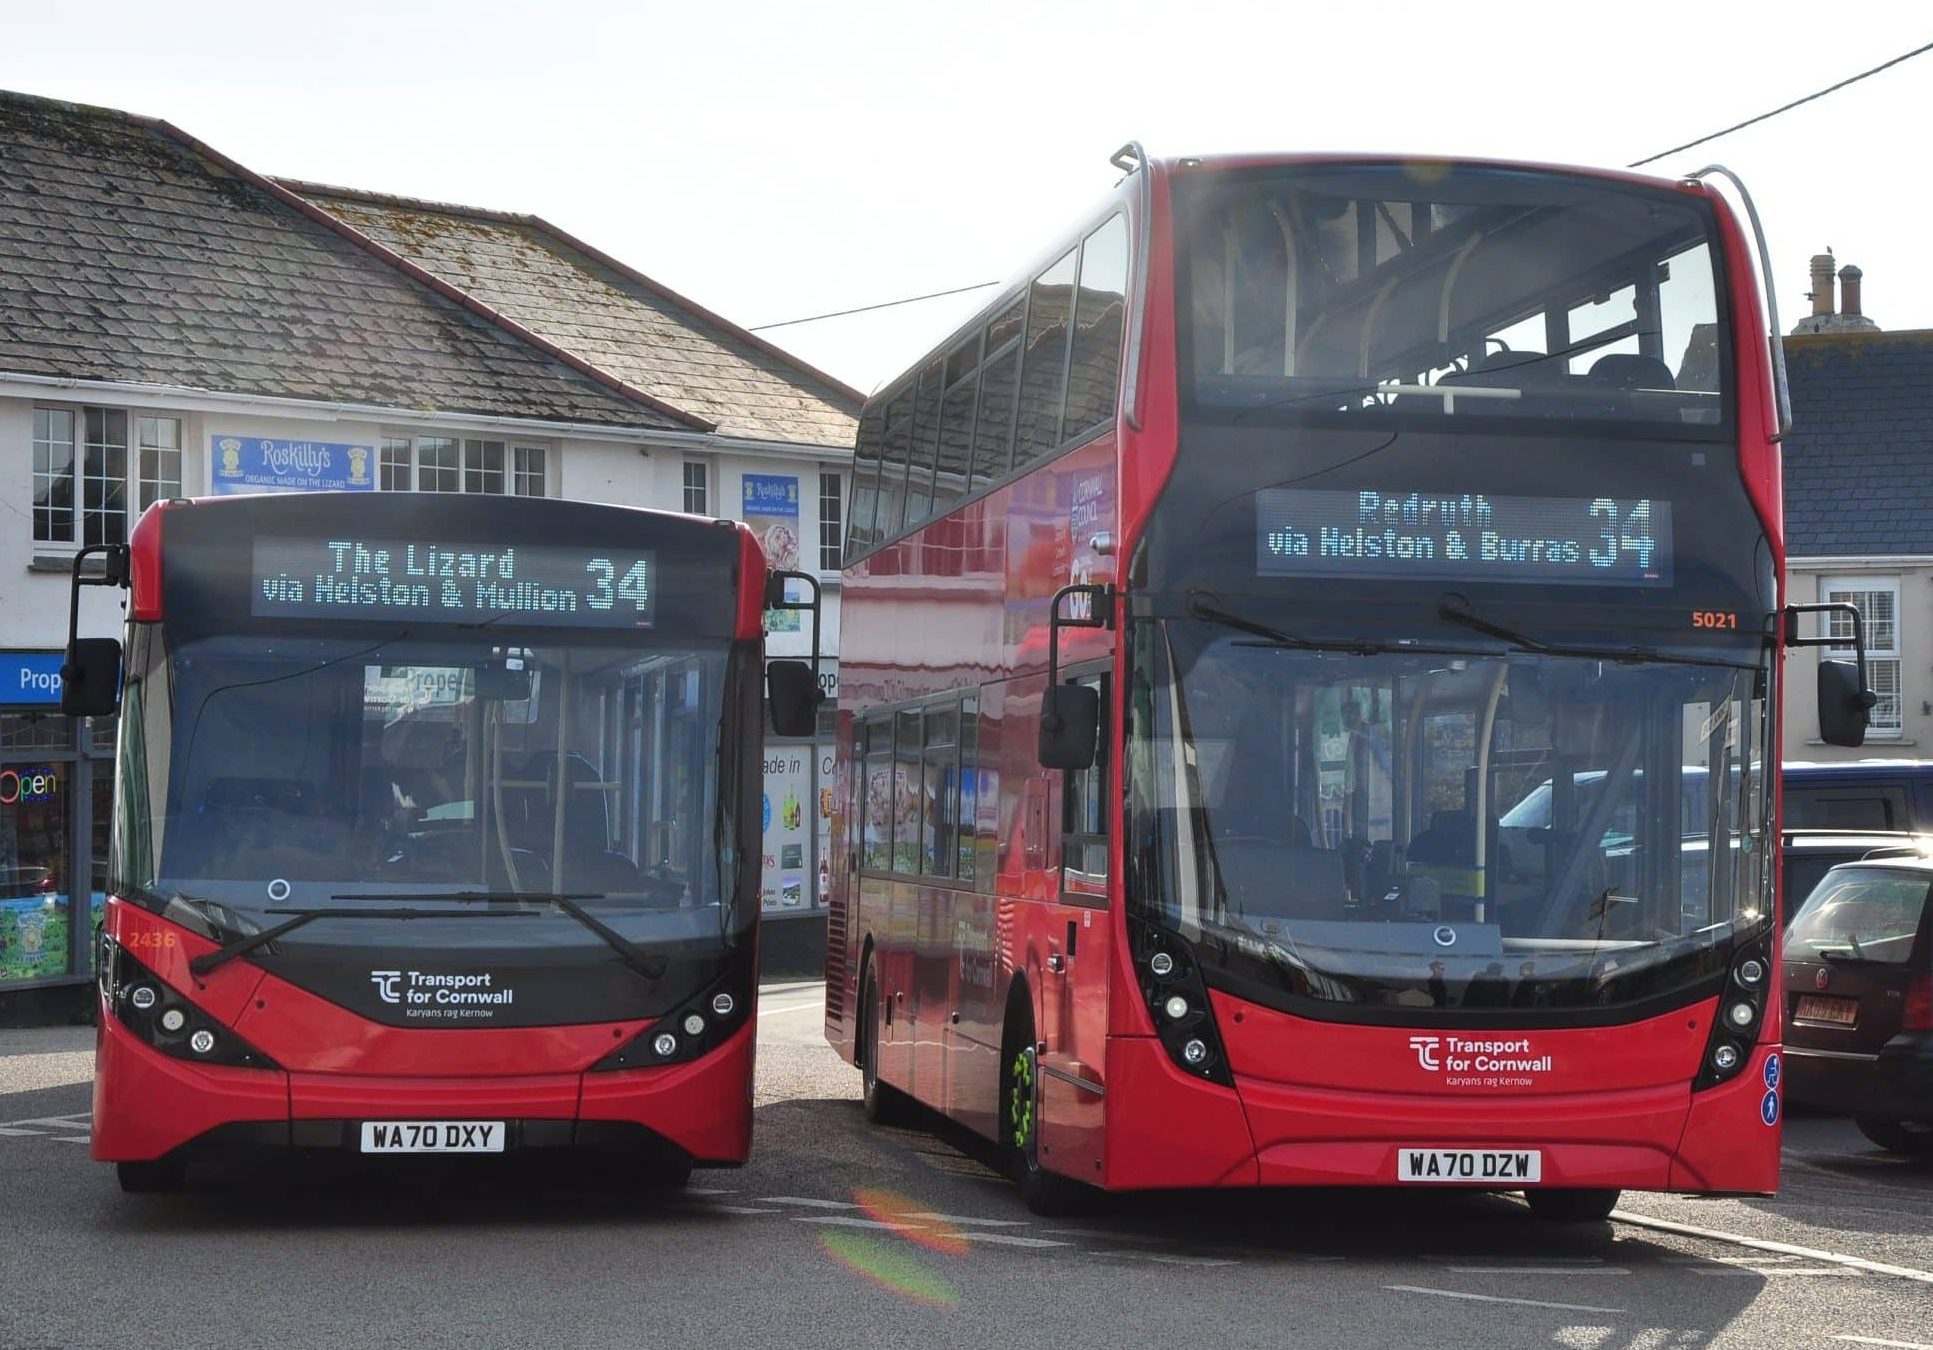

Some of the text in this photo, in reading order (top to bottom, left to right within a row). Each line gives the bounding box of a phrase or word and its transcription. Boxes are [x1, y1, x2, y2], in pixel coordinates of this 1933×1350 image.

[261, 440, 331, 477] Roskilly's
[245, 474, 275, 484] ORGANIC
[277, 476, 296, 485] MADE
[297, 477, 307, 486] ON
[309, 478, 320, 487] THE
[322, 479, 345, 488] LIZARD
[1360, 491, 1491, 526] Redruth
[1589, 498, 1655, 567] 34
[1268, 526, 1580, 562] via Helston & Burras
[328, 541, 514, 579] The Lizard
[263, 573, 576, 611] via Helston & Mullion
[586, 558, 648, 611] 34
[1693, 611, 1736, 629] 5021
[789, 755, 801, 774] in
[0, 770, 56, 804] Open
[130, 931, 176, 947] 2436
[407, 971, 491, 989] Transport
[406, 989, 513, 1004] for Cornwall
[406, 1008, 493, 1019] Karyans rag Kernow
[1446, 1037, 1529, 1056] Transport
[1446, 1056, 1552, 1071] for Cornwall
[1446, 1076, 1532, 1087] Karyans rag Kernow
[373, 1125, 493, 1148] WA70 DXY
[1410, 1153, 1529, 1177] WA70 DZW
